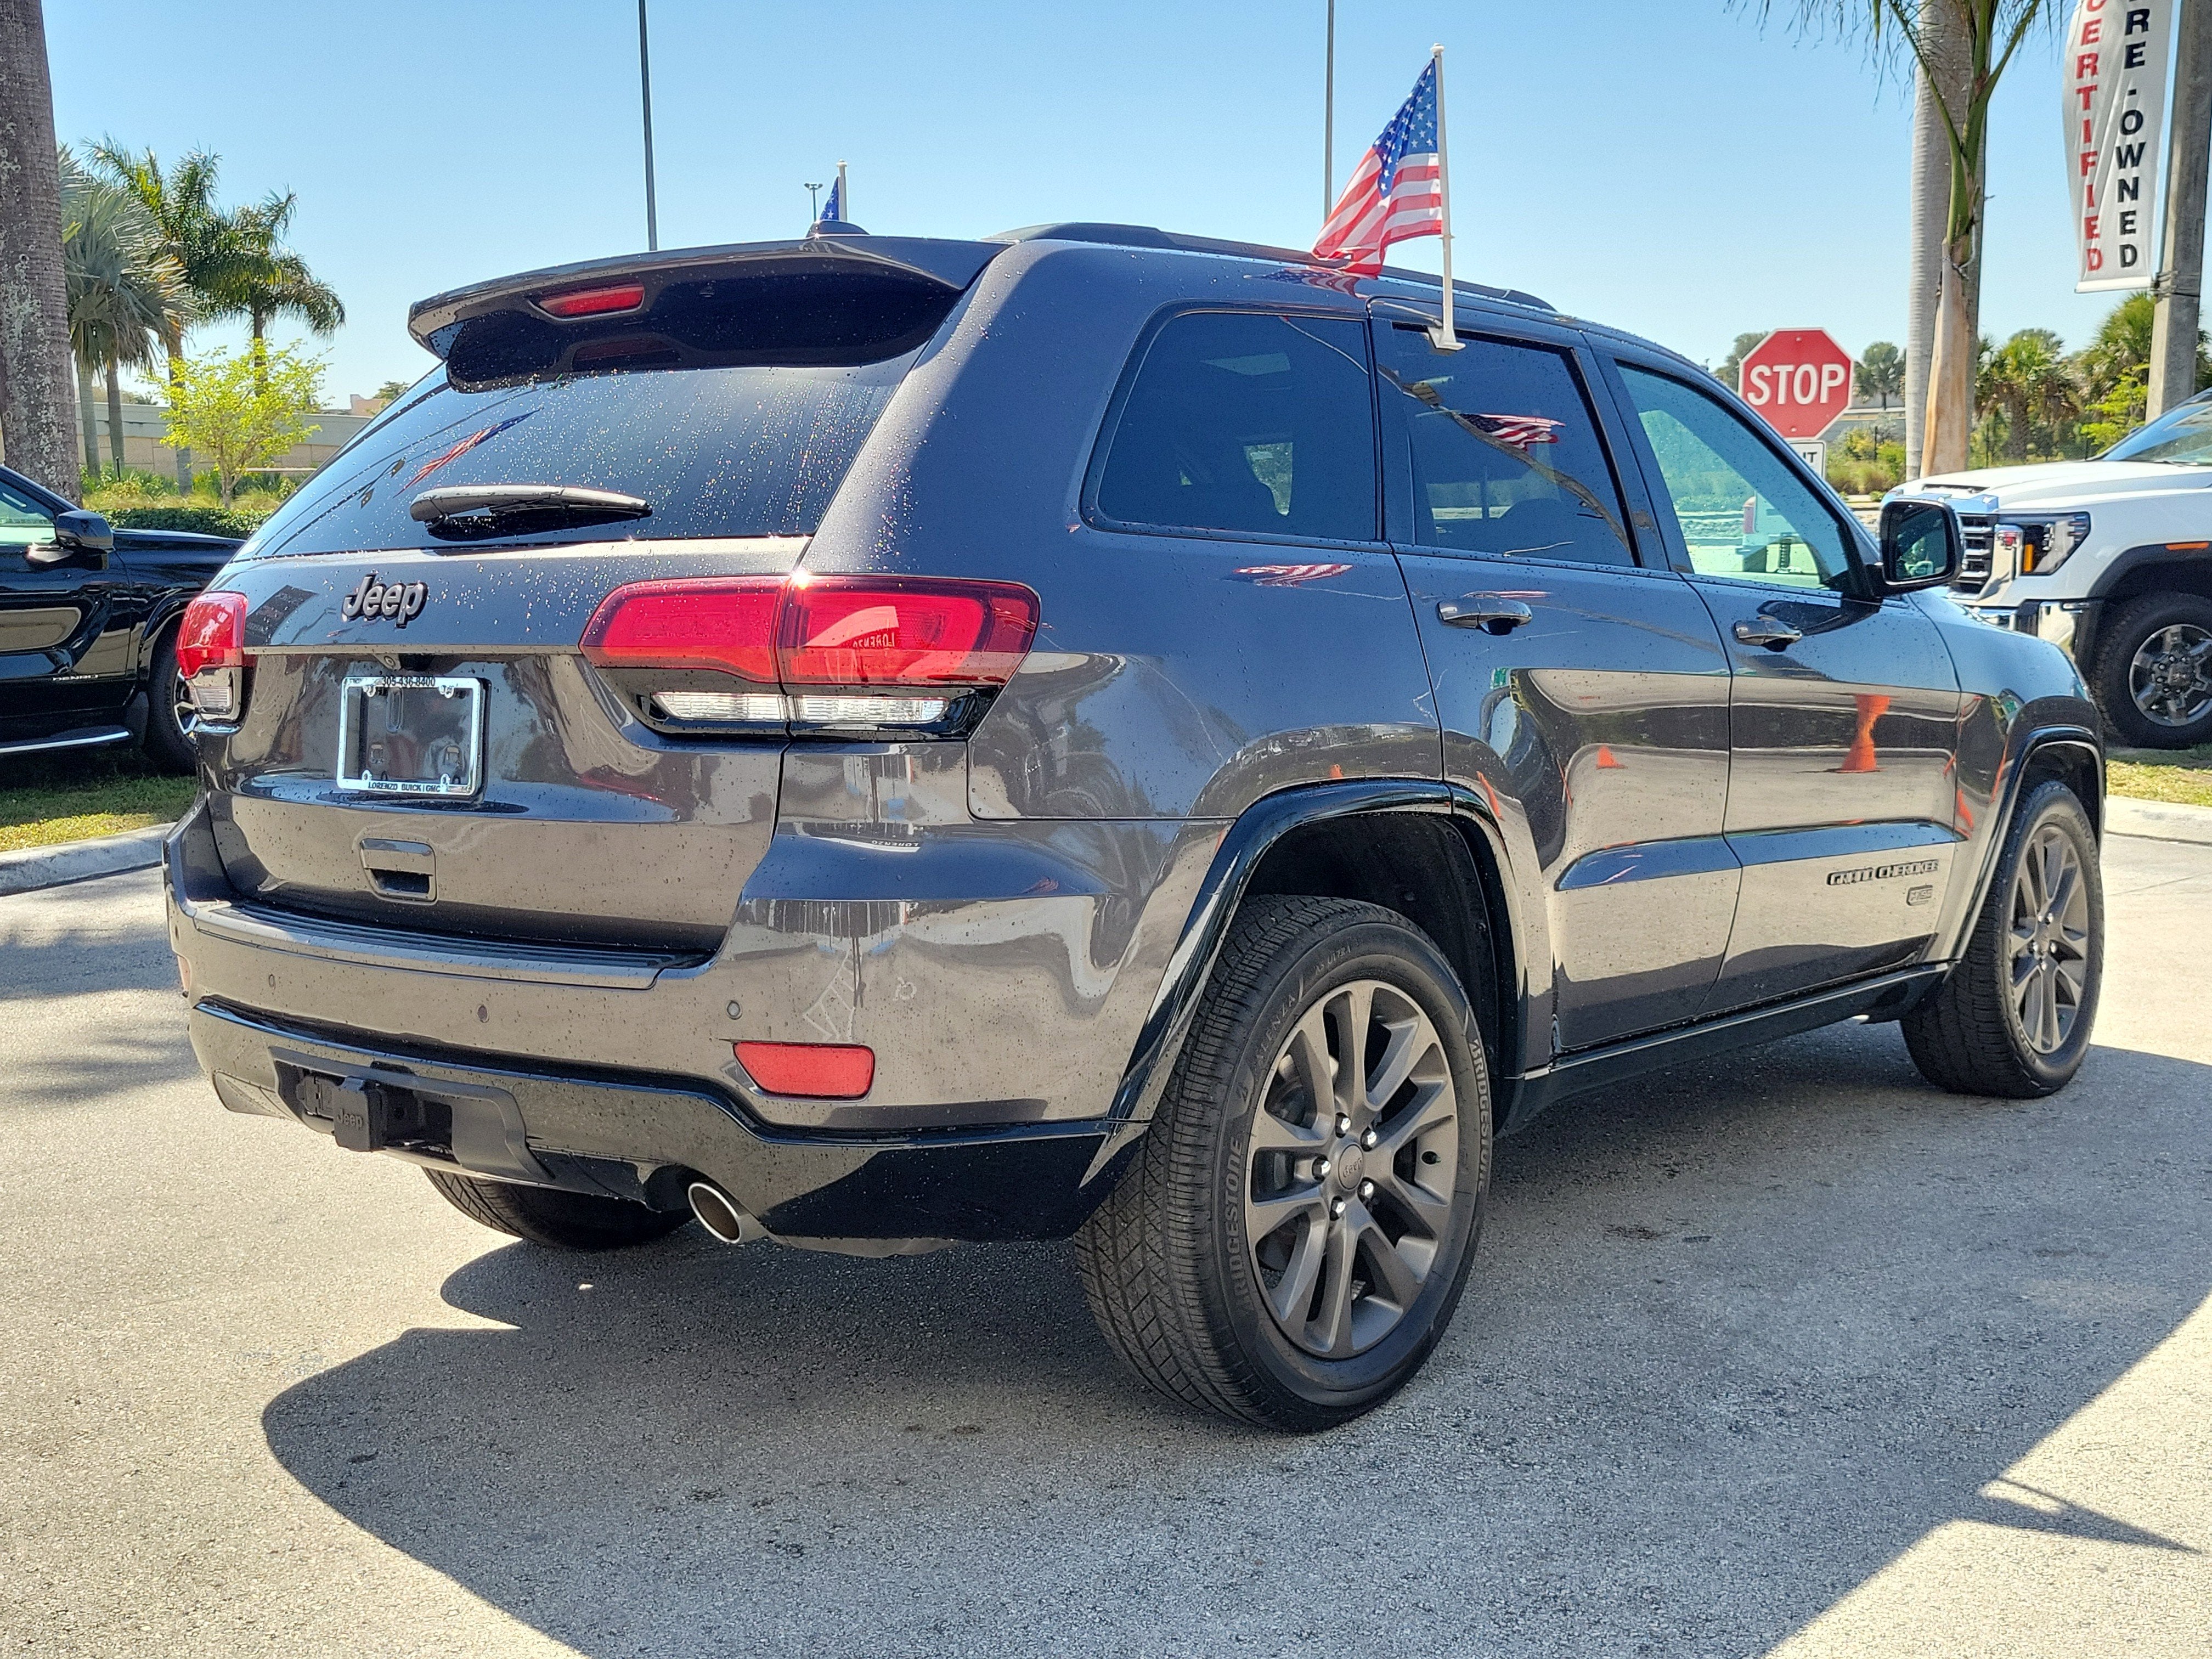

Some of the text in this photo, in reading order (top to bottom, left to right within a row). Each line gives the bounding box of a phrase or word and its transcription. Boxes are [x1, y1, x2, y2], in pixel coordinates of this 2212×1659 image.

[2115, 0, 2150, 268] RE-OWNED
[1747, 363, 1846, 406] STOP
[341, 574, 428, 629] Jeep
[382, 675, 436, 686] 305-436-8400
[368, 782, 398, 791] LORENZO
[402, 783, 421, 792] BUICK
[1875, 859, 1939, 879] CHEROKEE
[336, 1108, 364, 1130] Jeep
